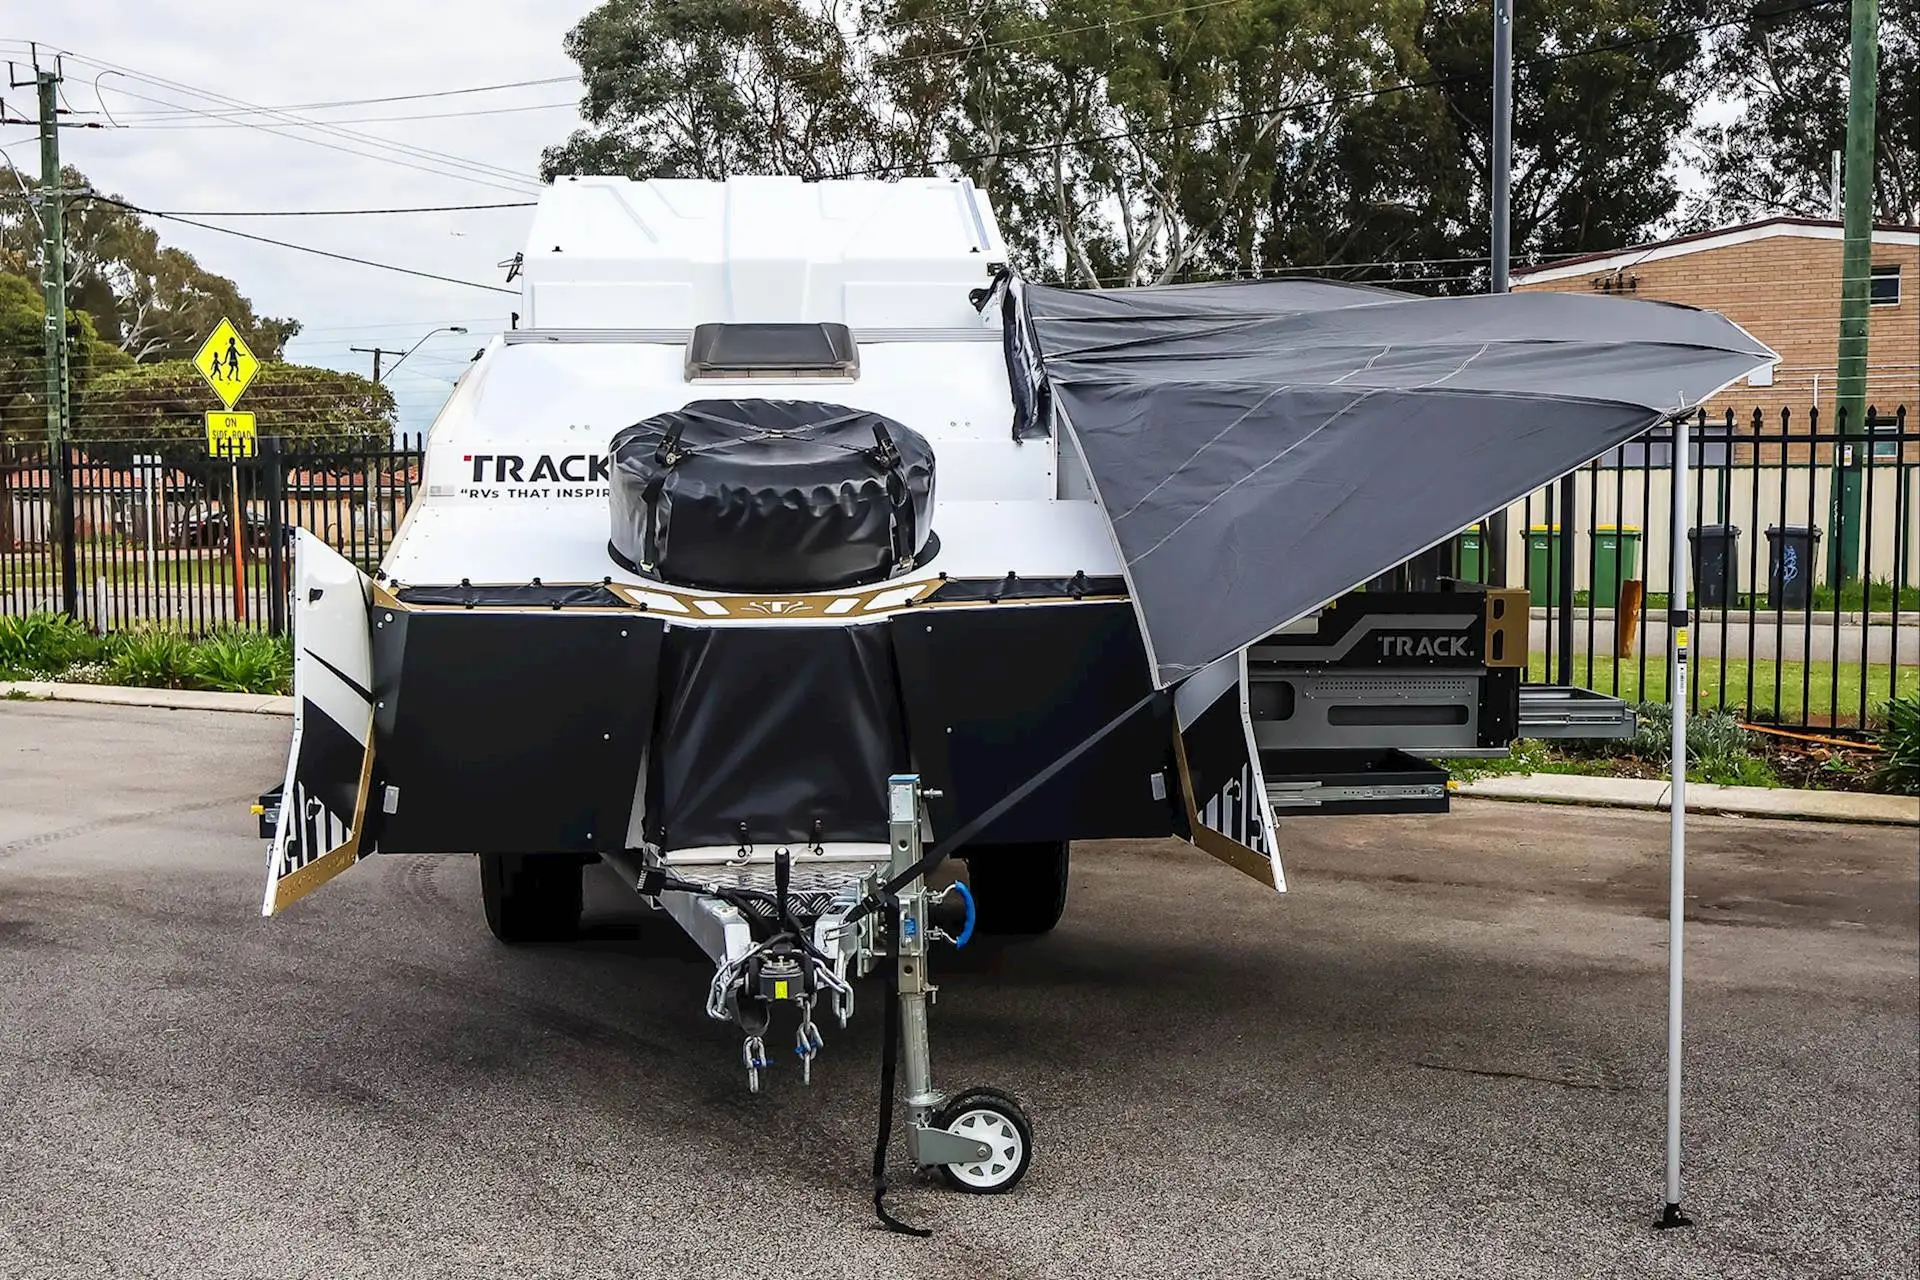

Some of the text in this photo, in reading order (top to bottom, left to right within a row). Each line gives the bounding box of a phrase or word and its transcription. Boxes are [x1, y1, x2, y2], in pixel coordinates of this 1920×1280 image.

[225, 417, 237, 427] ON
[212, 430, 251, 440] SIDE ROAD
[463, 454, 610, 483] TRACK
[508, 488, 551, 498] THAT
